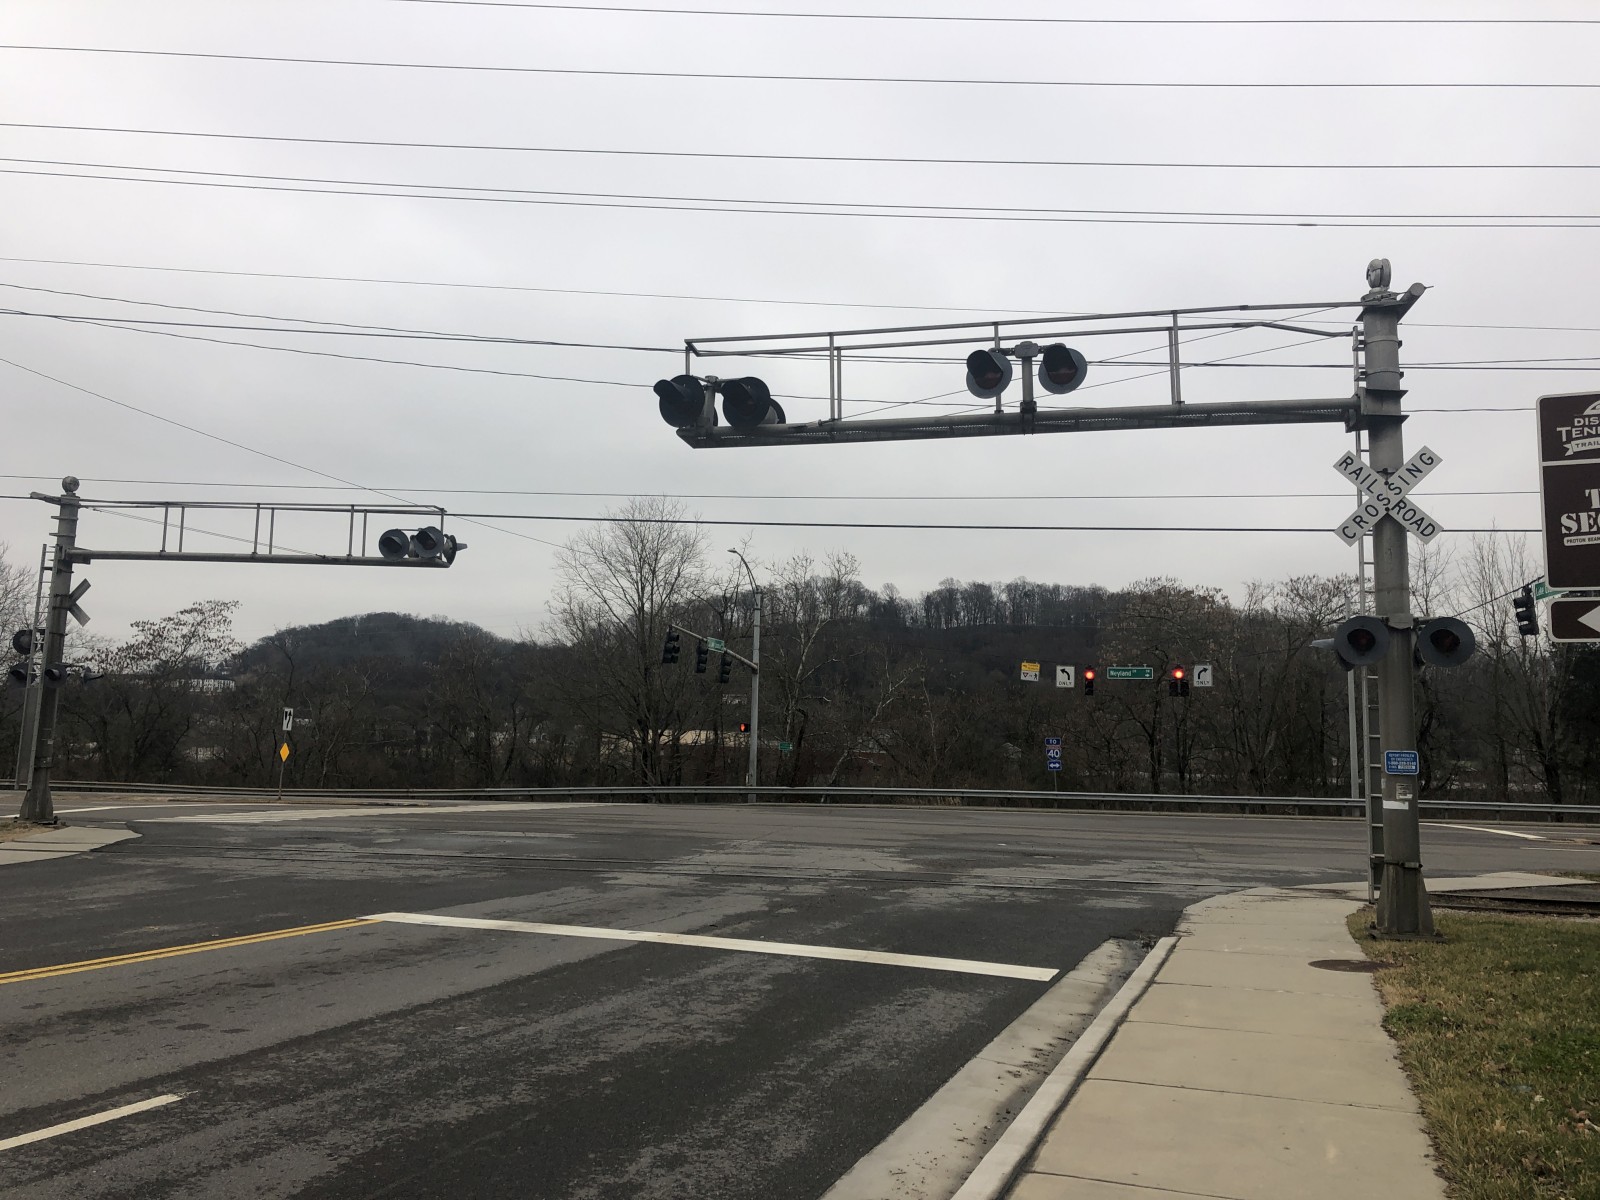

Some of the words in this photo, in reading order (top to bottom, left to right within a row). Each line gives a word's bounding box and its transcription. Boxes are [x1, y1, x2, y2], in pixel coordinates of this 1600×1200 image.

[1341, 452, 1435, 540] CROSSING
[1560, 511, 1600, 534] SE
[1109, 669, 1132, 677] Neyland
[1048, 749, 1060, 758] 40
